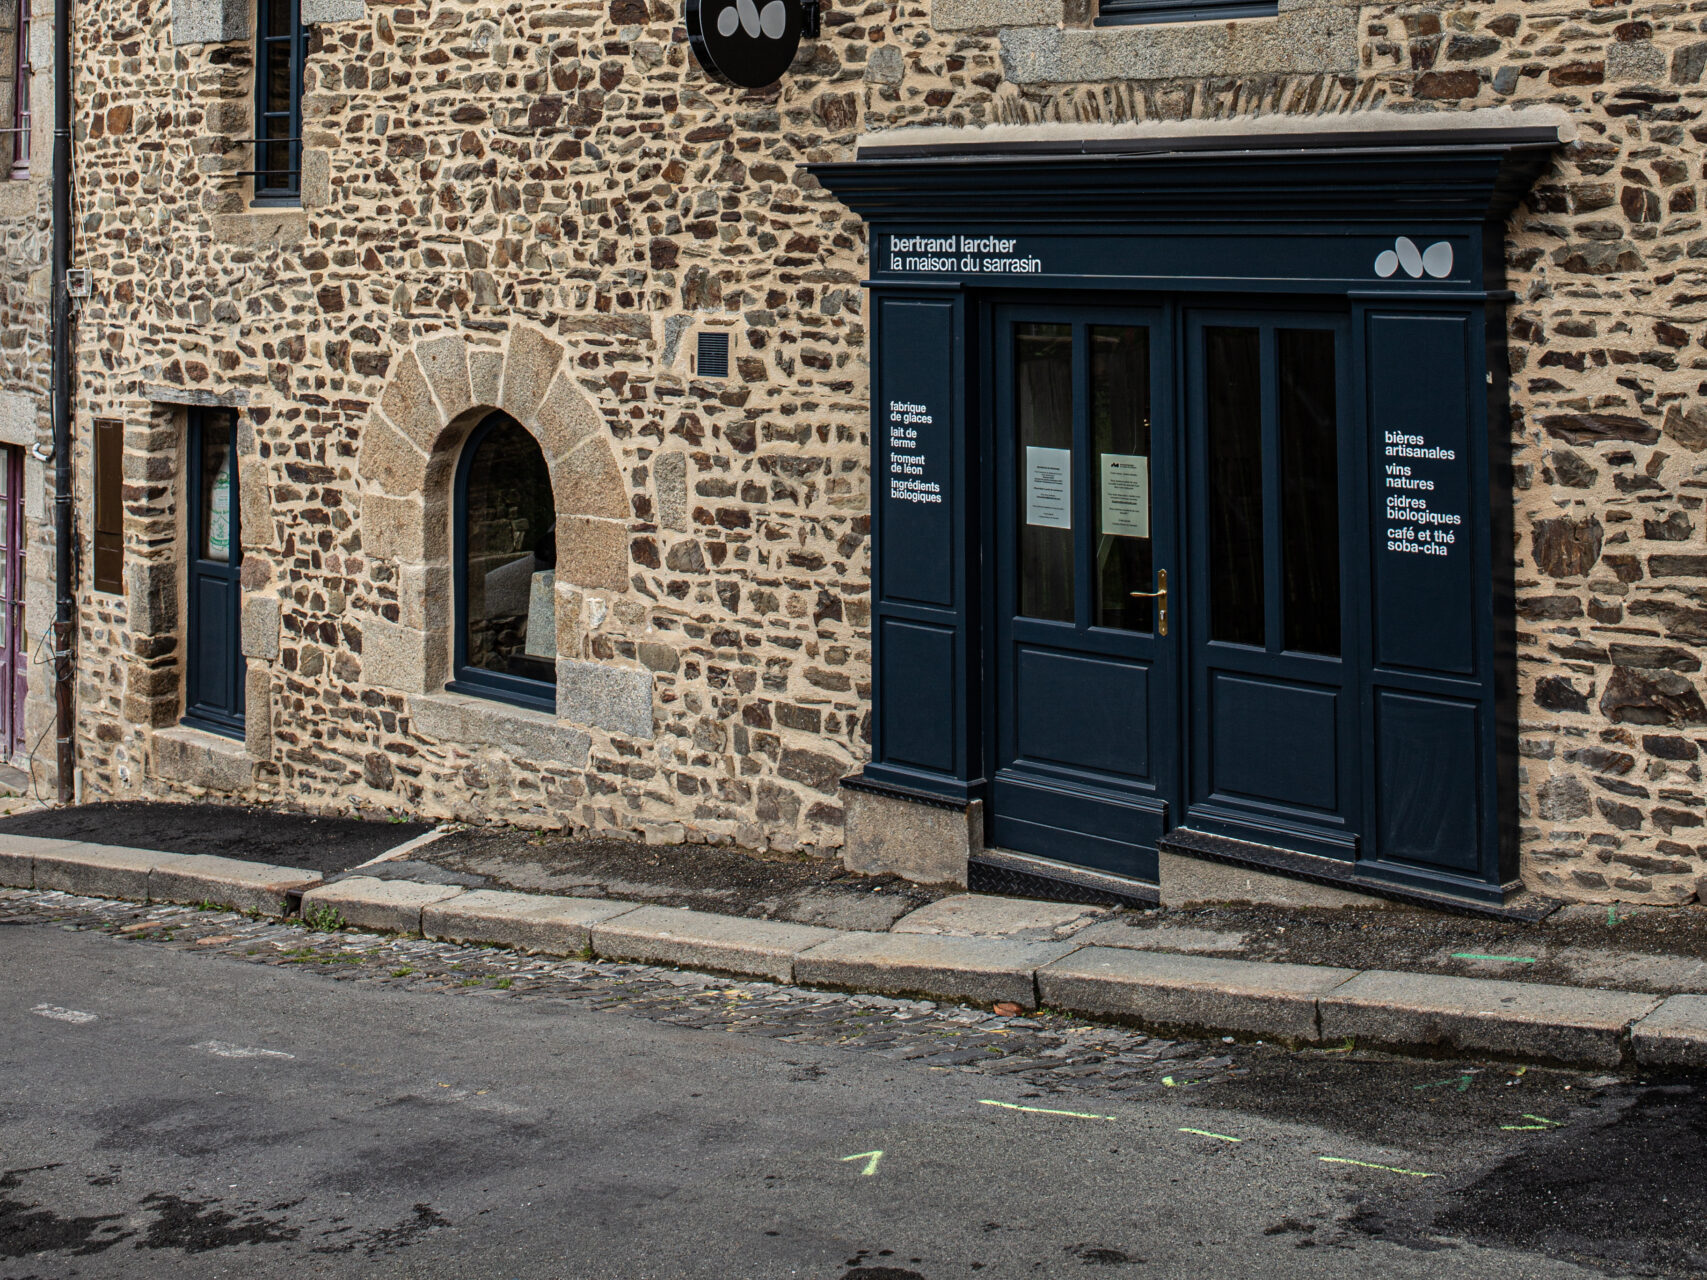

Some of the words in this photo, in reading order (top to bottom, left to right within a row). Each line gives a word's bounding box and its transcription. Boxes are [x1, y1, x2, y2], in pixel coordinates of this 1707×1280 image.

[890, 234, 956, 252] bertrand
[960, 235, 1016, 253] larcher
[890, 253, 902, 270] la
[906, 254, 957, 271] maison
[961, 254, 980, 272] du
[983, 255, 1042, 273] sarrasin
[890, 401, 926, 414] fabrique
[890, 411, 901, 421] de
[903, 412, 932, 424] glaces
[890, 426, 904, 437] lait
[906, 428, 917, 438] de
[1385, 430, 1424, 445] bières
[890, 437, 916, 448] ferme
[890, 452, 925, 465] froment
[1385, 444, 1455, 460] artisanales
[890, 462, 902, 473] de
[903, 463, 923, 475] léon
[1385, 463, 1411, 476] vins
[890, 477, 940, 492] ingrédients
[1386, 477, 1434, 490] natures
[891, 488, 942, 503] biologiques
[1386, 494, 1426, 509] cidres
[1386, 507, 1461, 525] biologiques
[1387, 526, 1415, 540] café
[1418, 529, 1431, 541] et
[1434, 530, 1455, 544] thé
[1387, 540, 1448, 556] soba-cha
